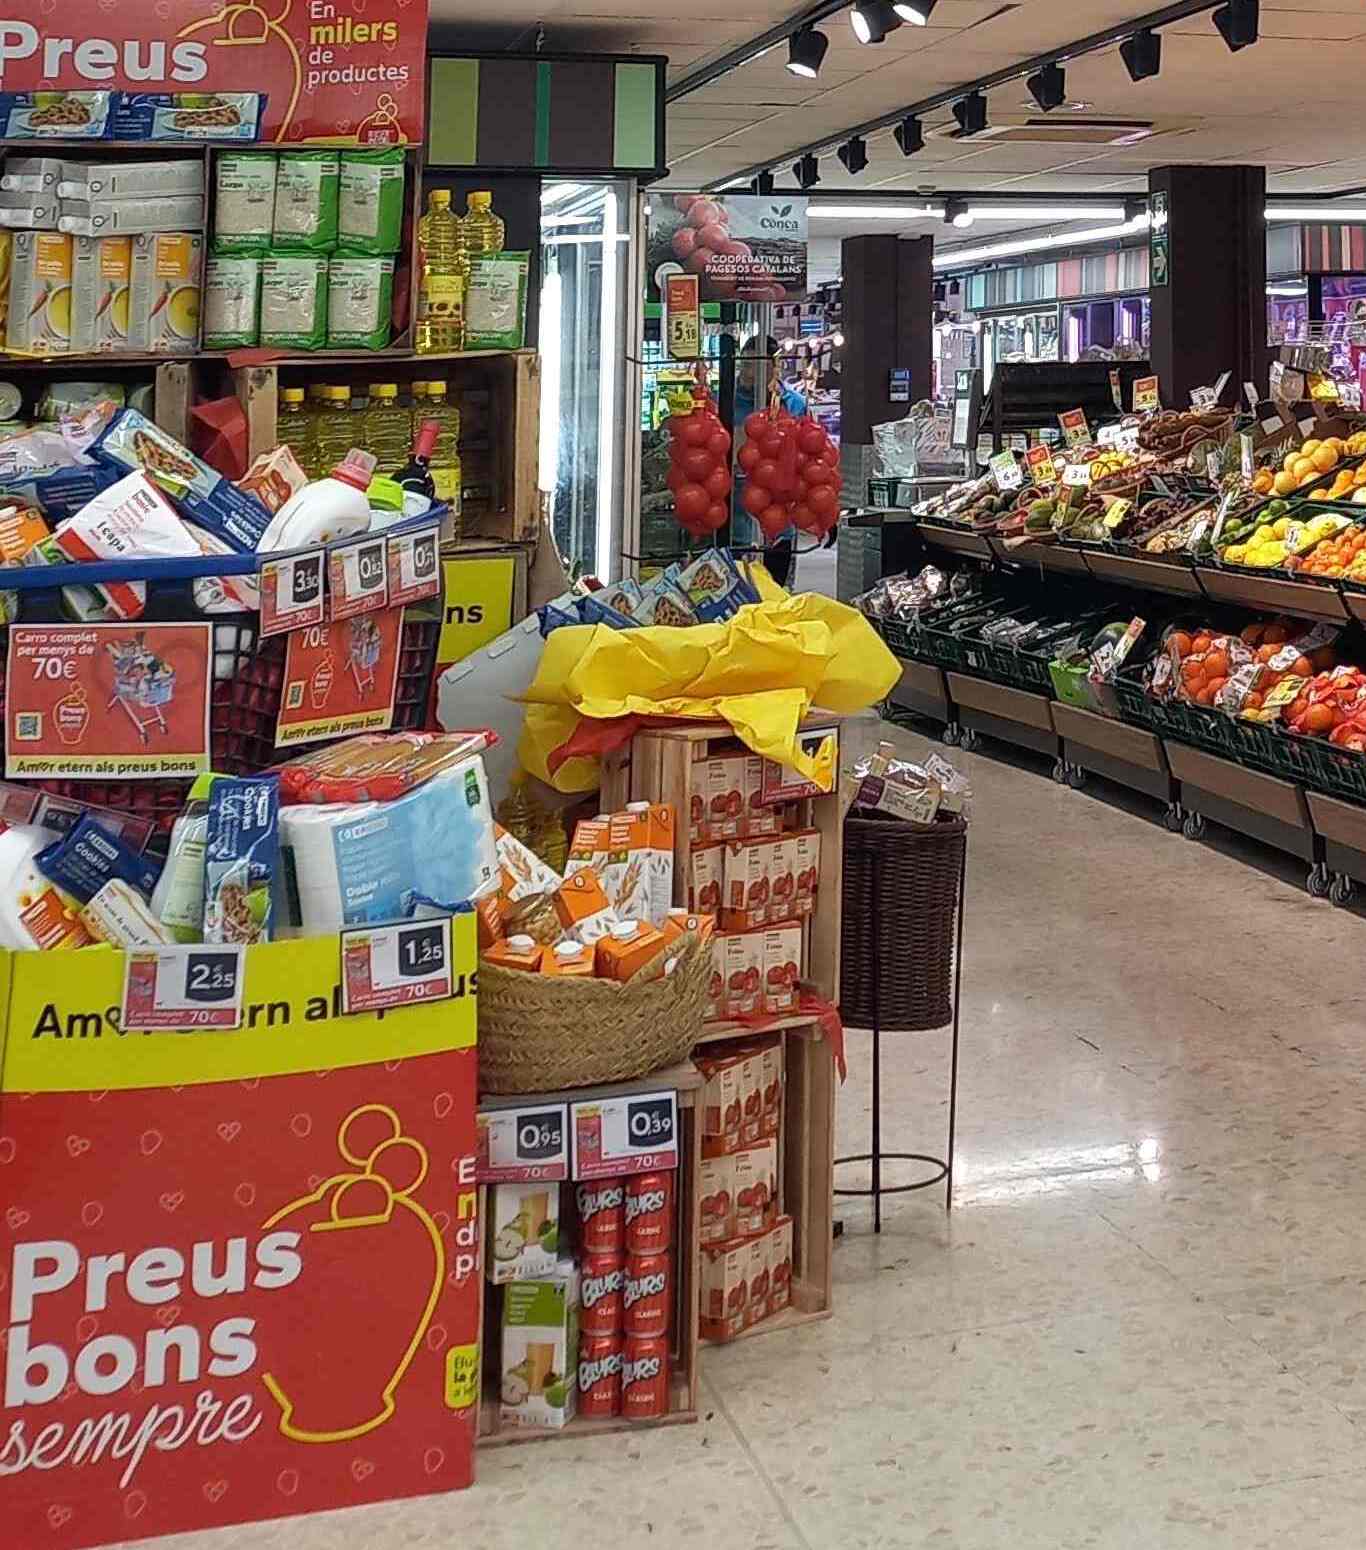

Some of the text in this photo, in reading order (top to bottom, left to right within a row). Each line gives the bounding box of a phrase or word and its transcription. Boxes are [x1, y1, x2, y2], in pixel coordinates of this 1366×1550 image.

[311, 2, 335, 19] En
[310, 20, 397, 44] milers
[0, 20, 207, 82] Preus
[308, 49, 333, 65] de
[307, 64, 409, 84] productes
[705, 264, 802, 273] PAGESOS CATALANS
[711, 254, 796, 264] COOPERATIVA DE
[15, 631, 98, 646] Carro complet
[17, 646, 36, 657] per
[78, 644, 95, 655] de
[31, 657, 79, 680] 70€
[59, 761, 93, 773] etern
[96, 760, 115, 773] als
[118, 761, 157, 775] preus
[160, 760, 196, 772] bons
[305, 983, 341, 1018] al
[11, 1229, 303, 1324] Preus
[3, 1314, 257, 1408] bons
[0, 1391, 264, 1489] sempre
